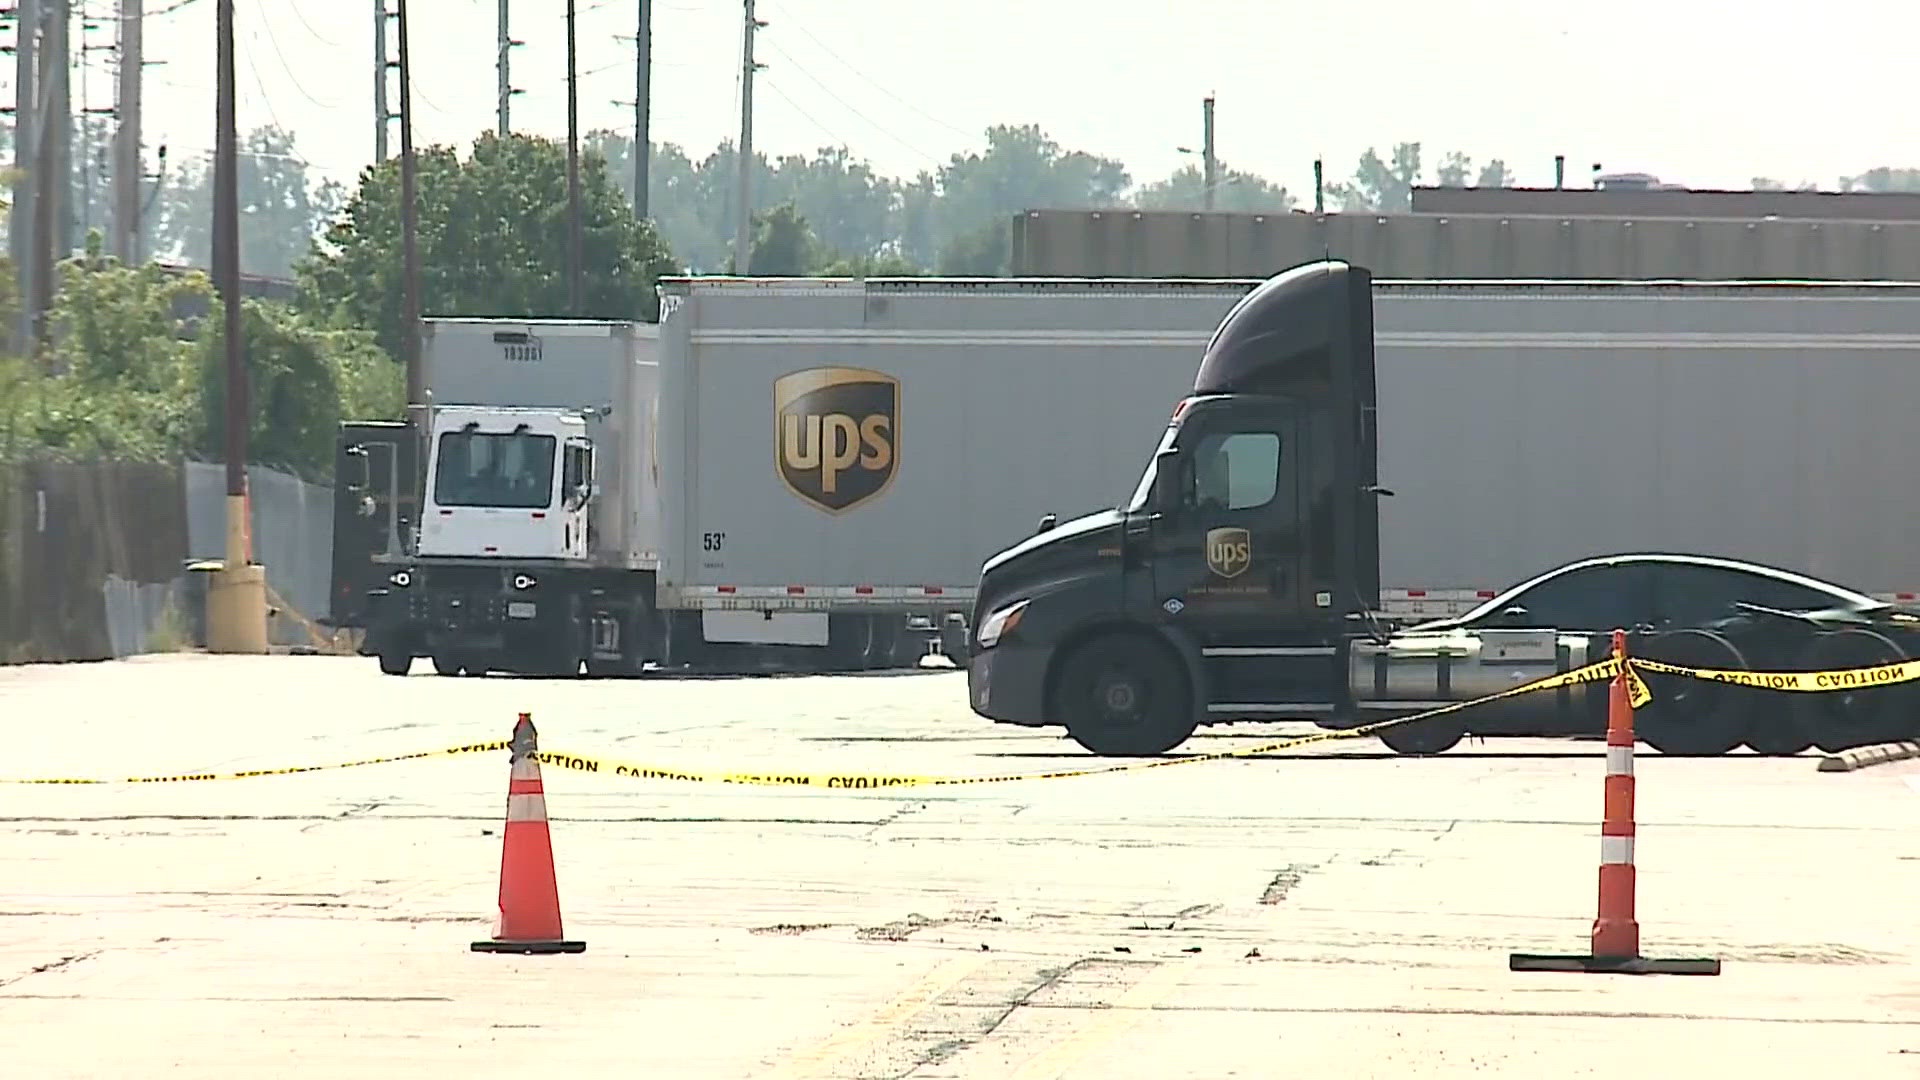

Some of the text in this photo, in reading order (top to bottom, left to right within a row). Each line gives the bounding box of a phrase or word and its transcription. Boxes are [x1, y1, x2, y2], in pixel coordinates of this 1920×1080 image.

[784, 412, 891, 494] ups
[704, 532, 726, 551] 53'
[1209, 543, 1248, 571] ups
